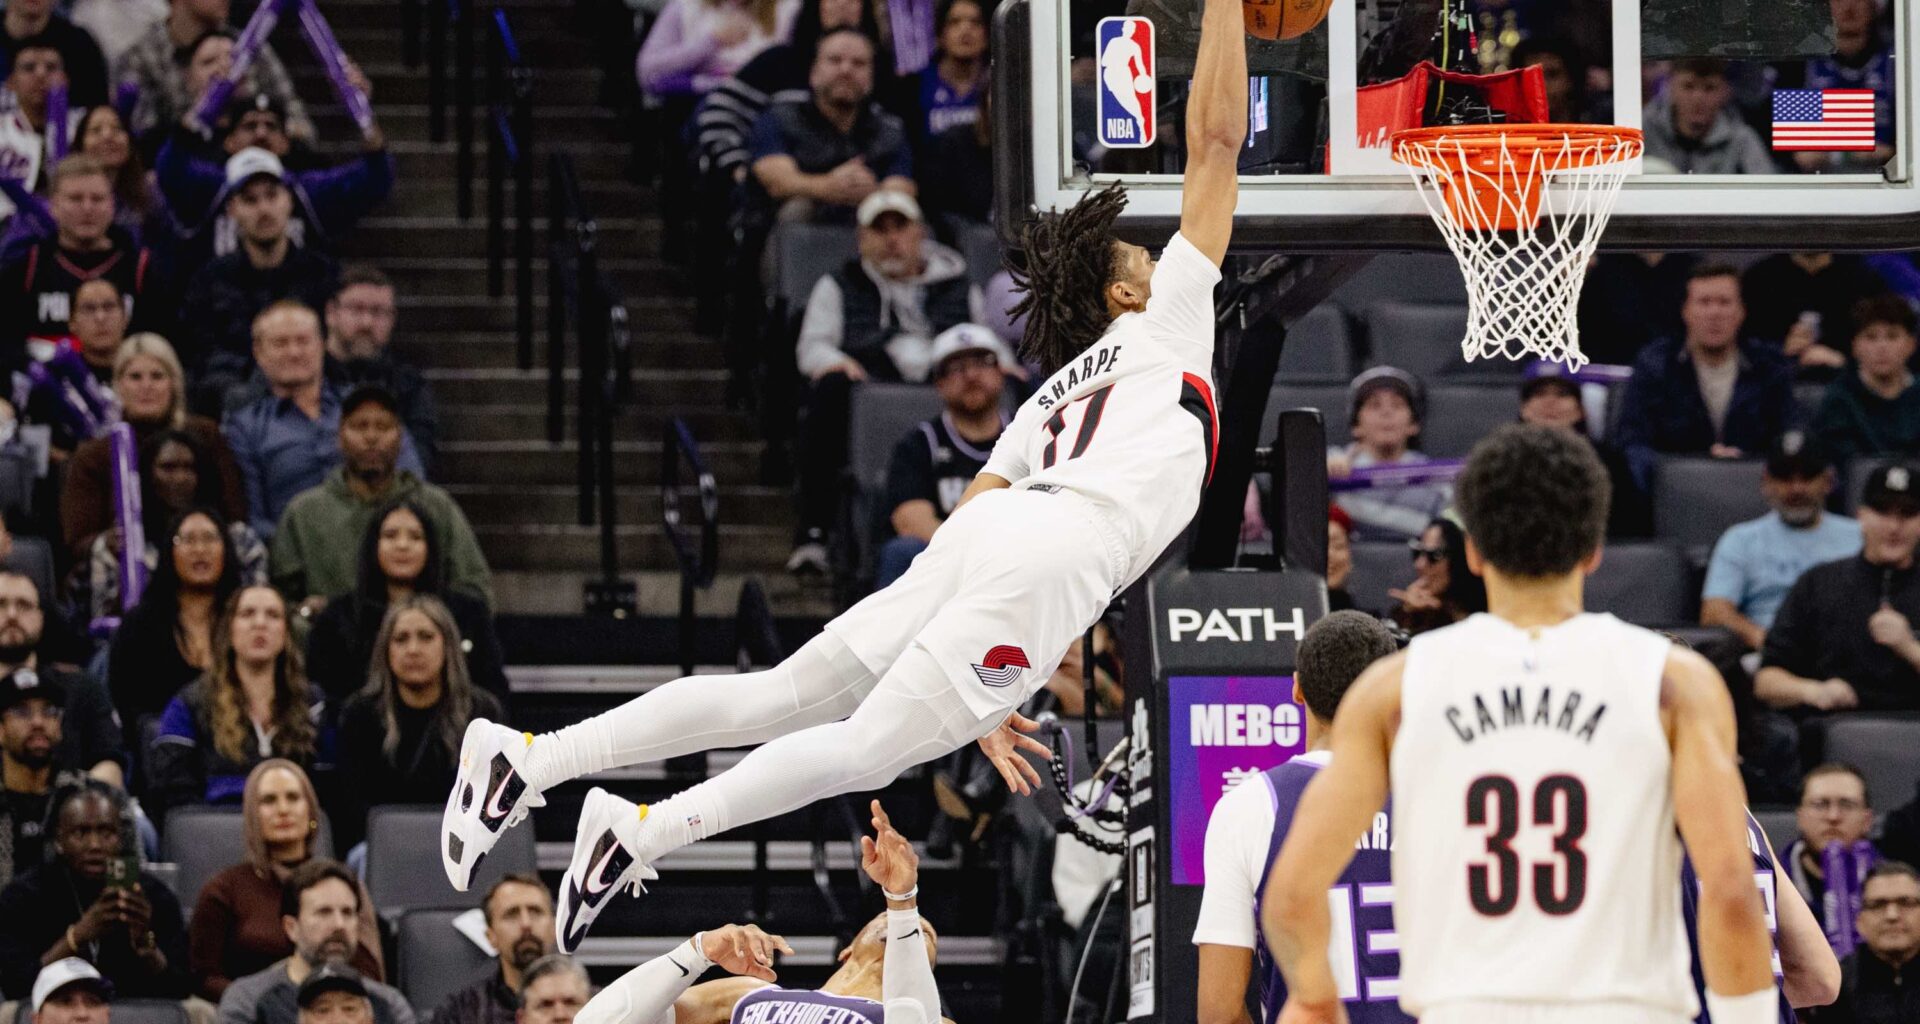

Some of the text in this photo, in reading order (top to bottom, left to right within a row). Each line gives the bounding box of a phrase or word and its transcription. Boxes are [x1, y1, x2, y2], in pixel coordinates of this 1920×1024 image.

[1106, 118, 1135, 139] NBA
[1037, 345, 1122, 410] SHARPE
[1041, 382, 1117, 471] 17
[1168, 607, 1306, 642] PATH
[1190, 703, 1301, 748] MEBO
[1445, 685, 1608, 745] CAMARA
[1465, 772, 1589, 918] 33
[740, 1000, 874, 1024] SACRAMENT
